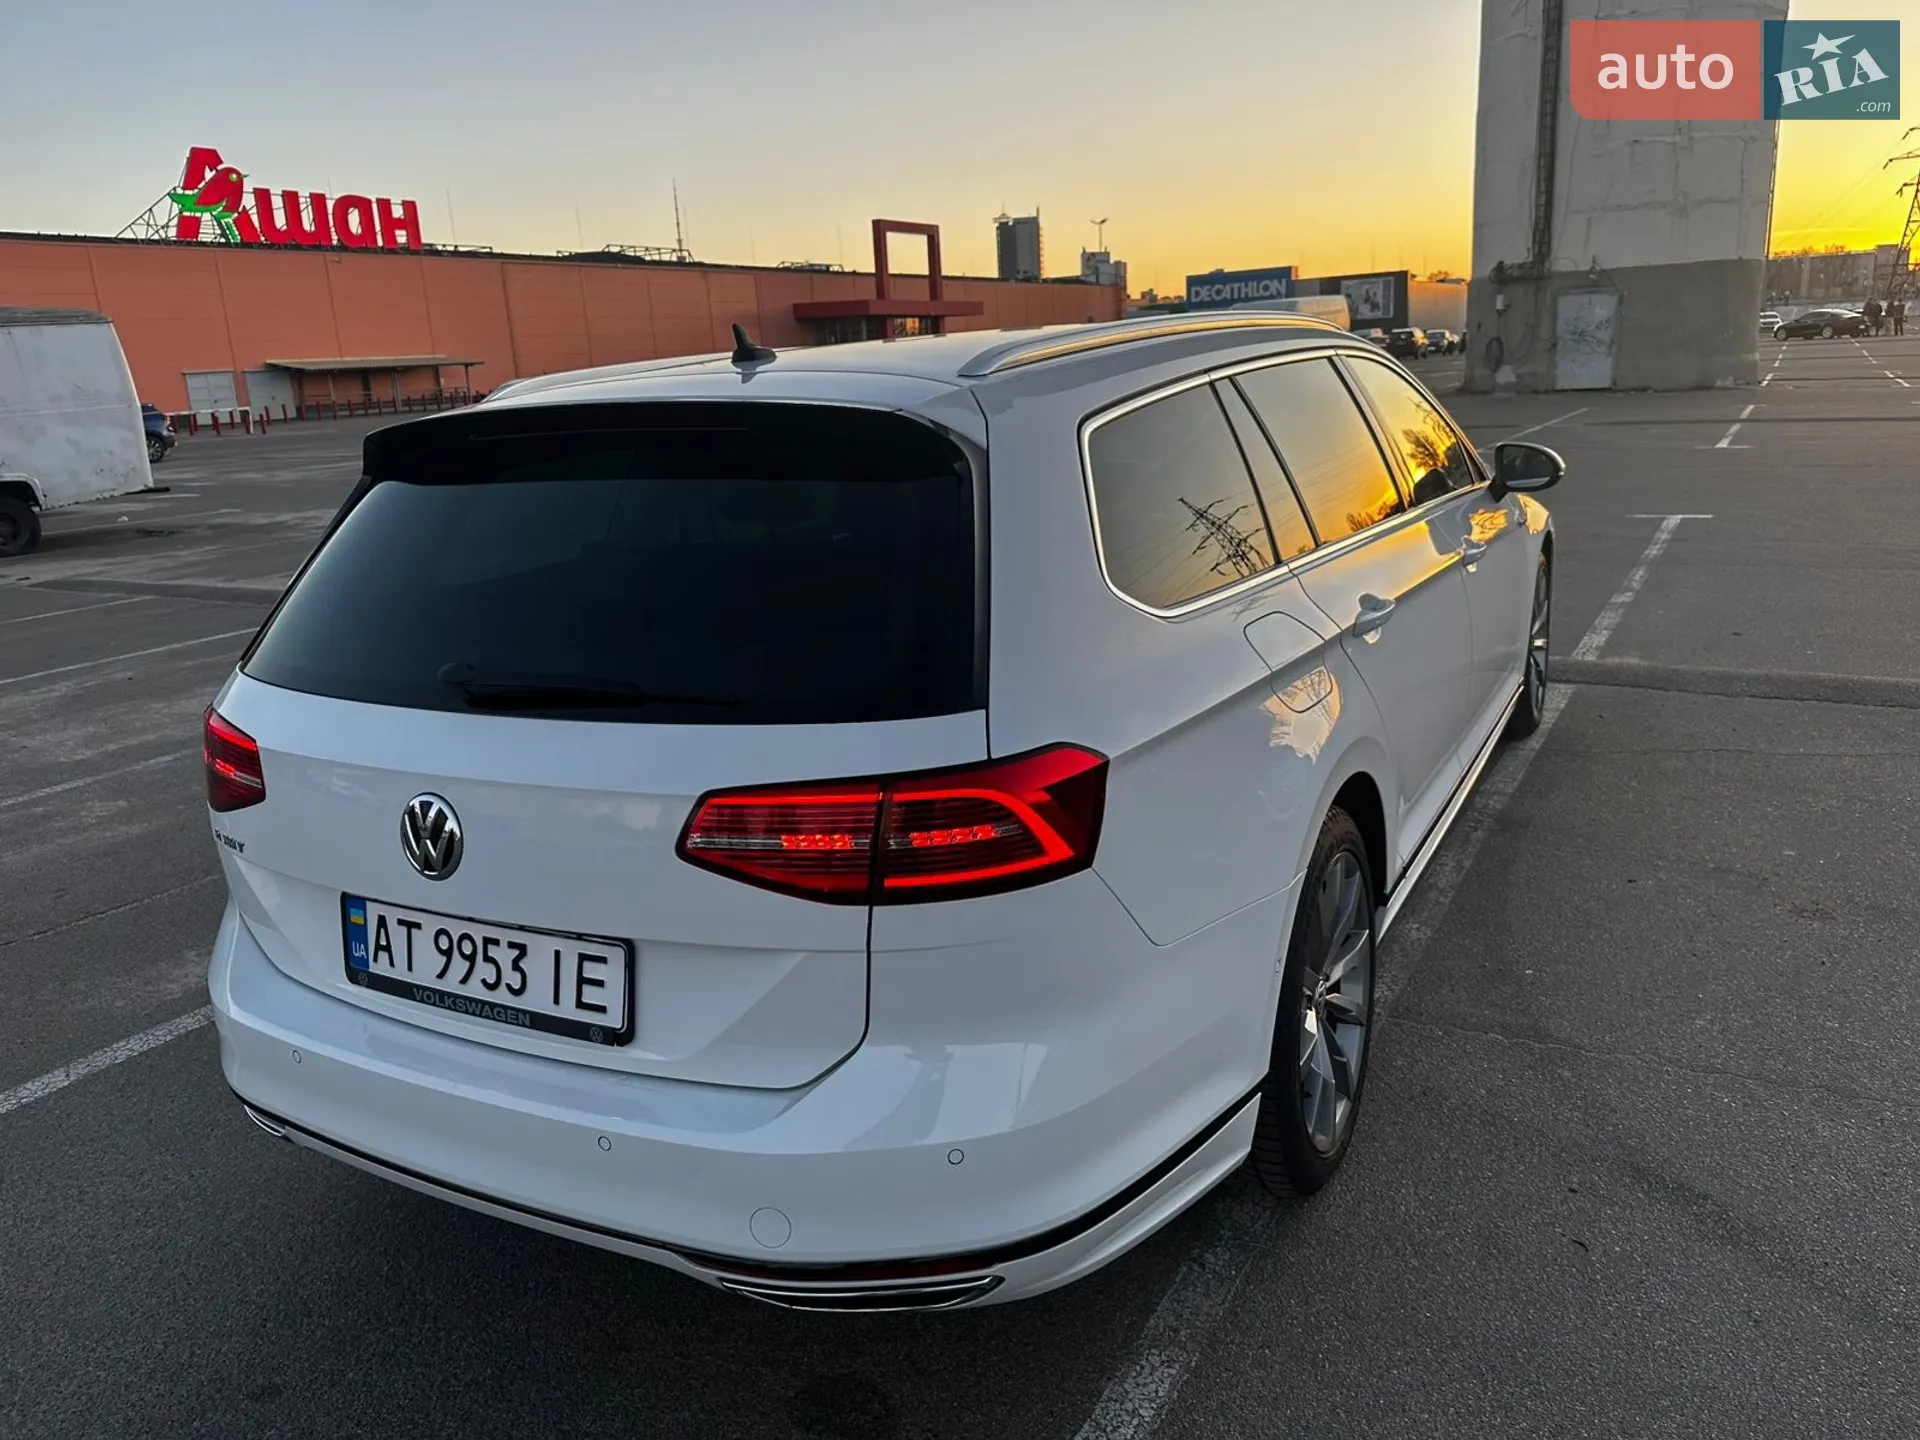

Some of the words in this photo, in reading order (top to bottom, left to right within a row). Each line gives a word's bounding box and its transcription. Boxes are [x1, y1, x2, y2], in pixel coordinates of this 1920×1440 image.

[175, 146, 422, 249] Ашан
[1190, 279, 1287, 303] DECATHLON
[352, 942, 367, 960] UA
[372, 914, 422, 972] AT
[433, 927, 528, 996] 9953
[553, 948, 608, 1014] IE
[413, 987, 531, 1027] VOLKSWAGEN
